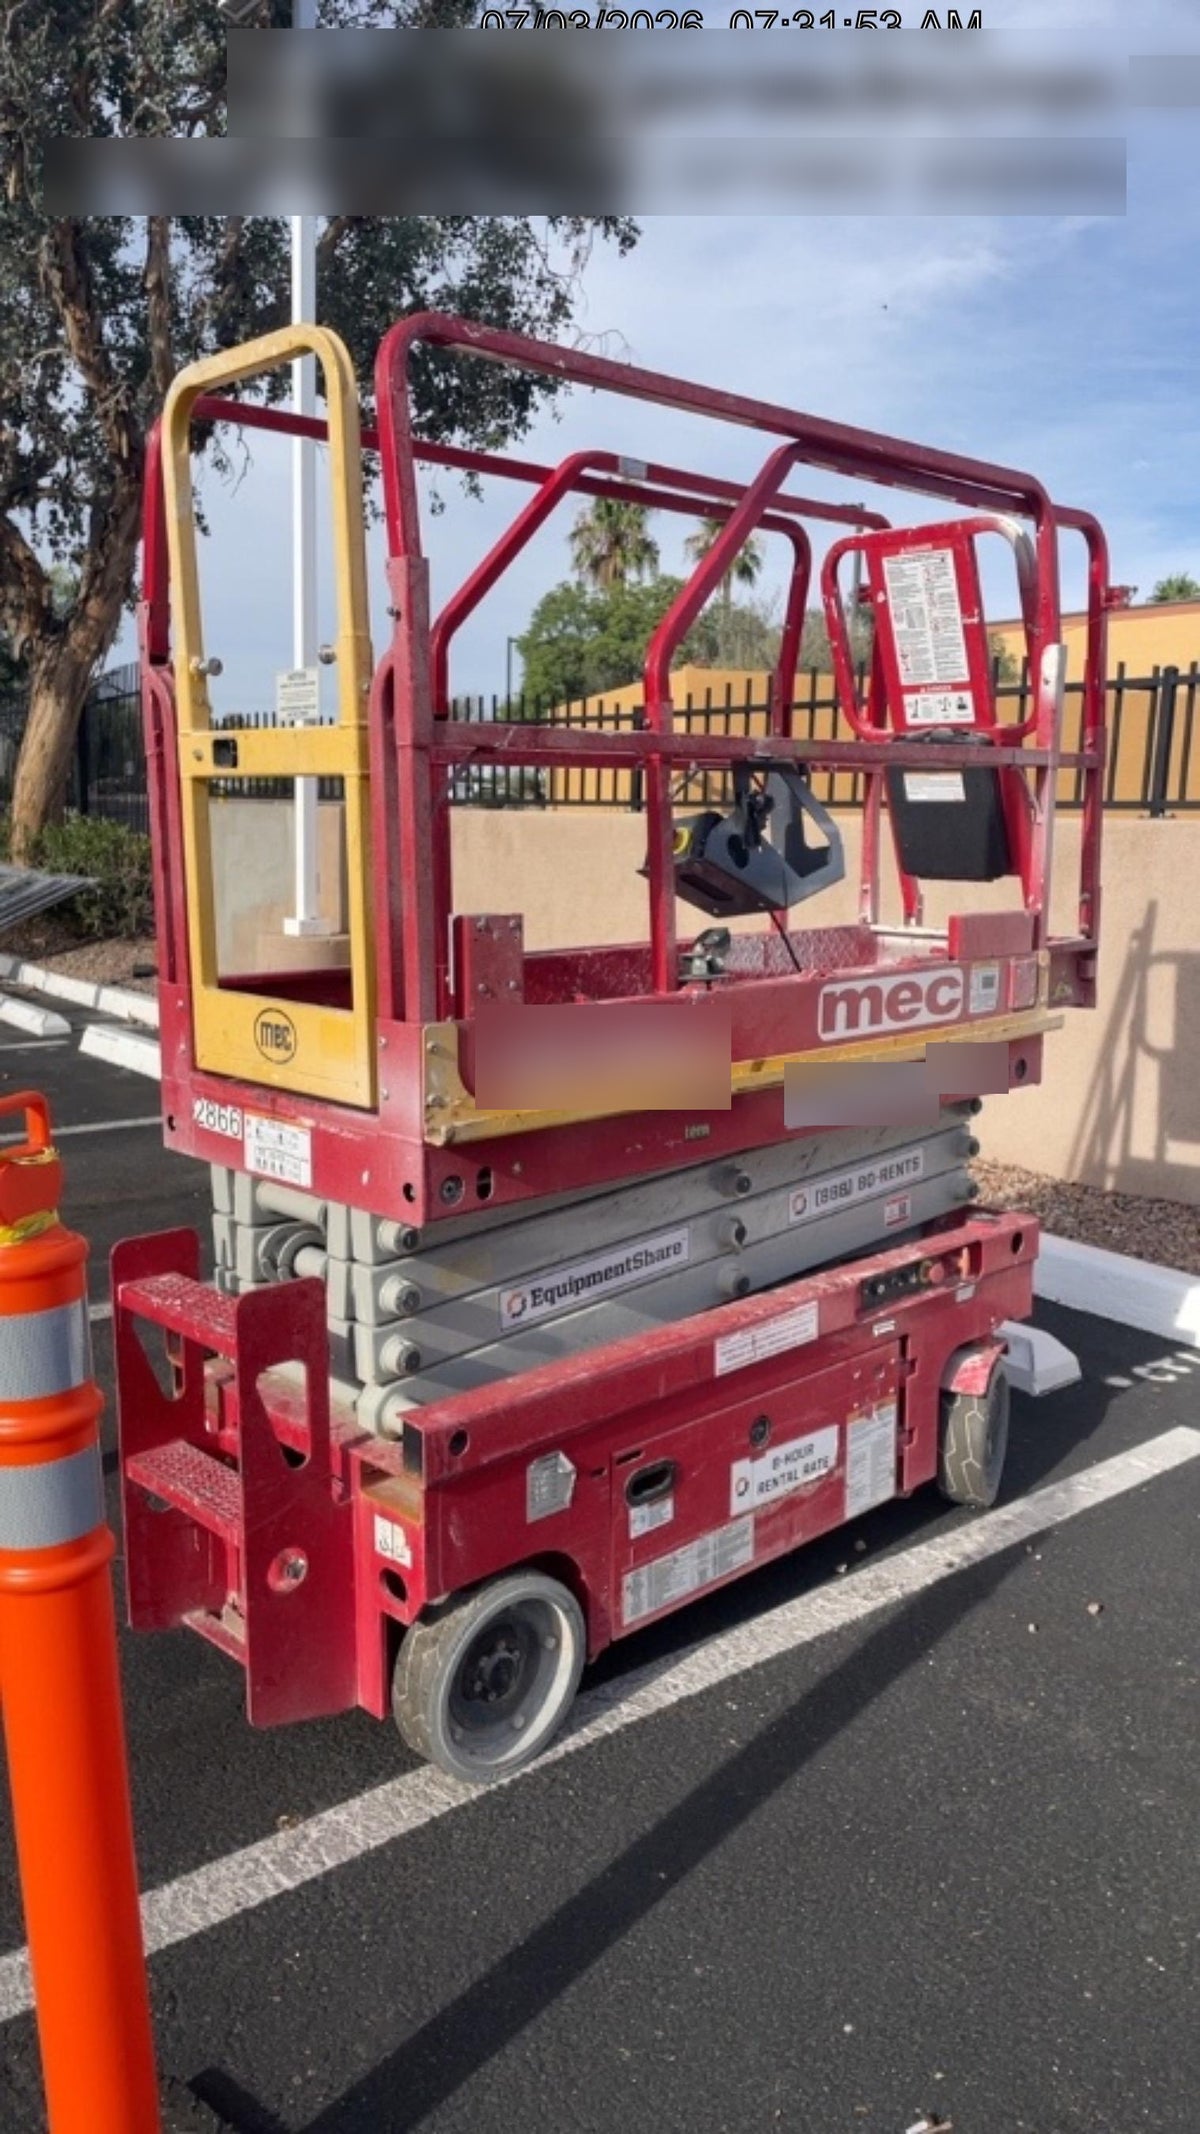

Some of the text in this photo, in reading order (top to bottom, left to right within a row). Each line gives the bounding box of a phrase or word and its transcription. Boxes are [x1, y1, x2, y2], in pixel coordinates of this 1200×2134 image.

[821, 976, 962, 1034] mec
[195, 1100, 241, 1136] 2866
[529, 1240, 683, 1308] EquipmentShare
[757, 1456, 830, 1494] RENTAL RATE
